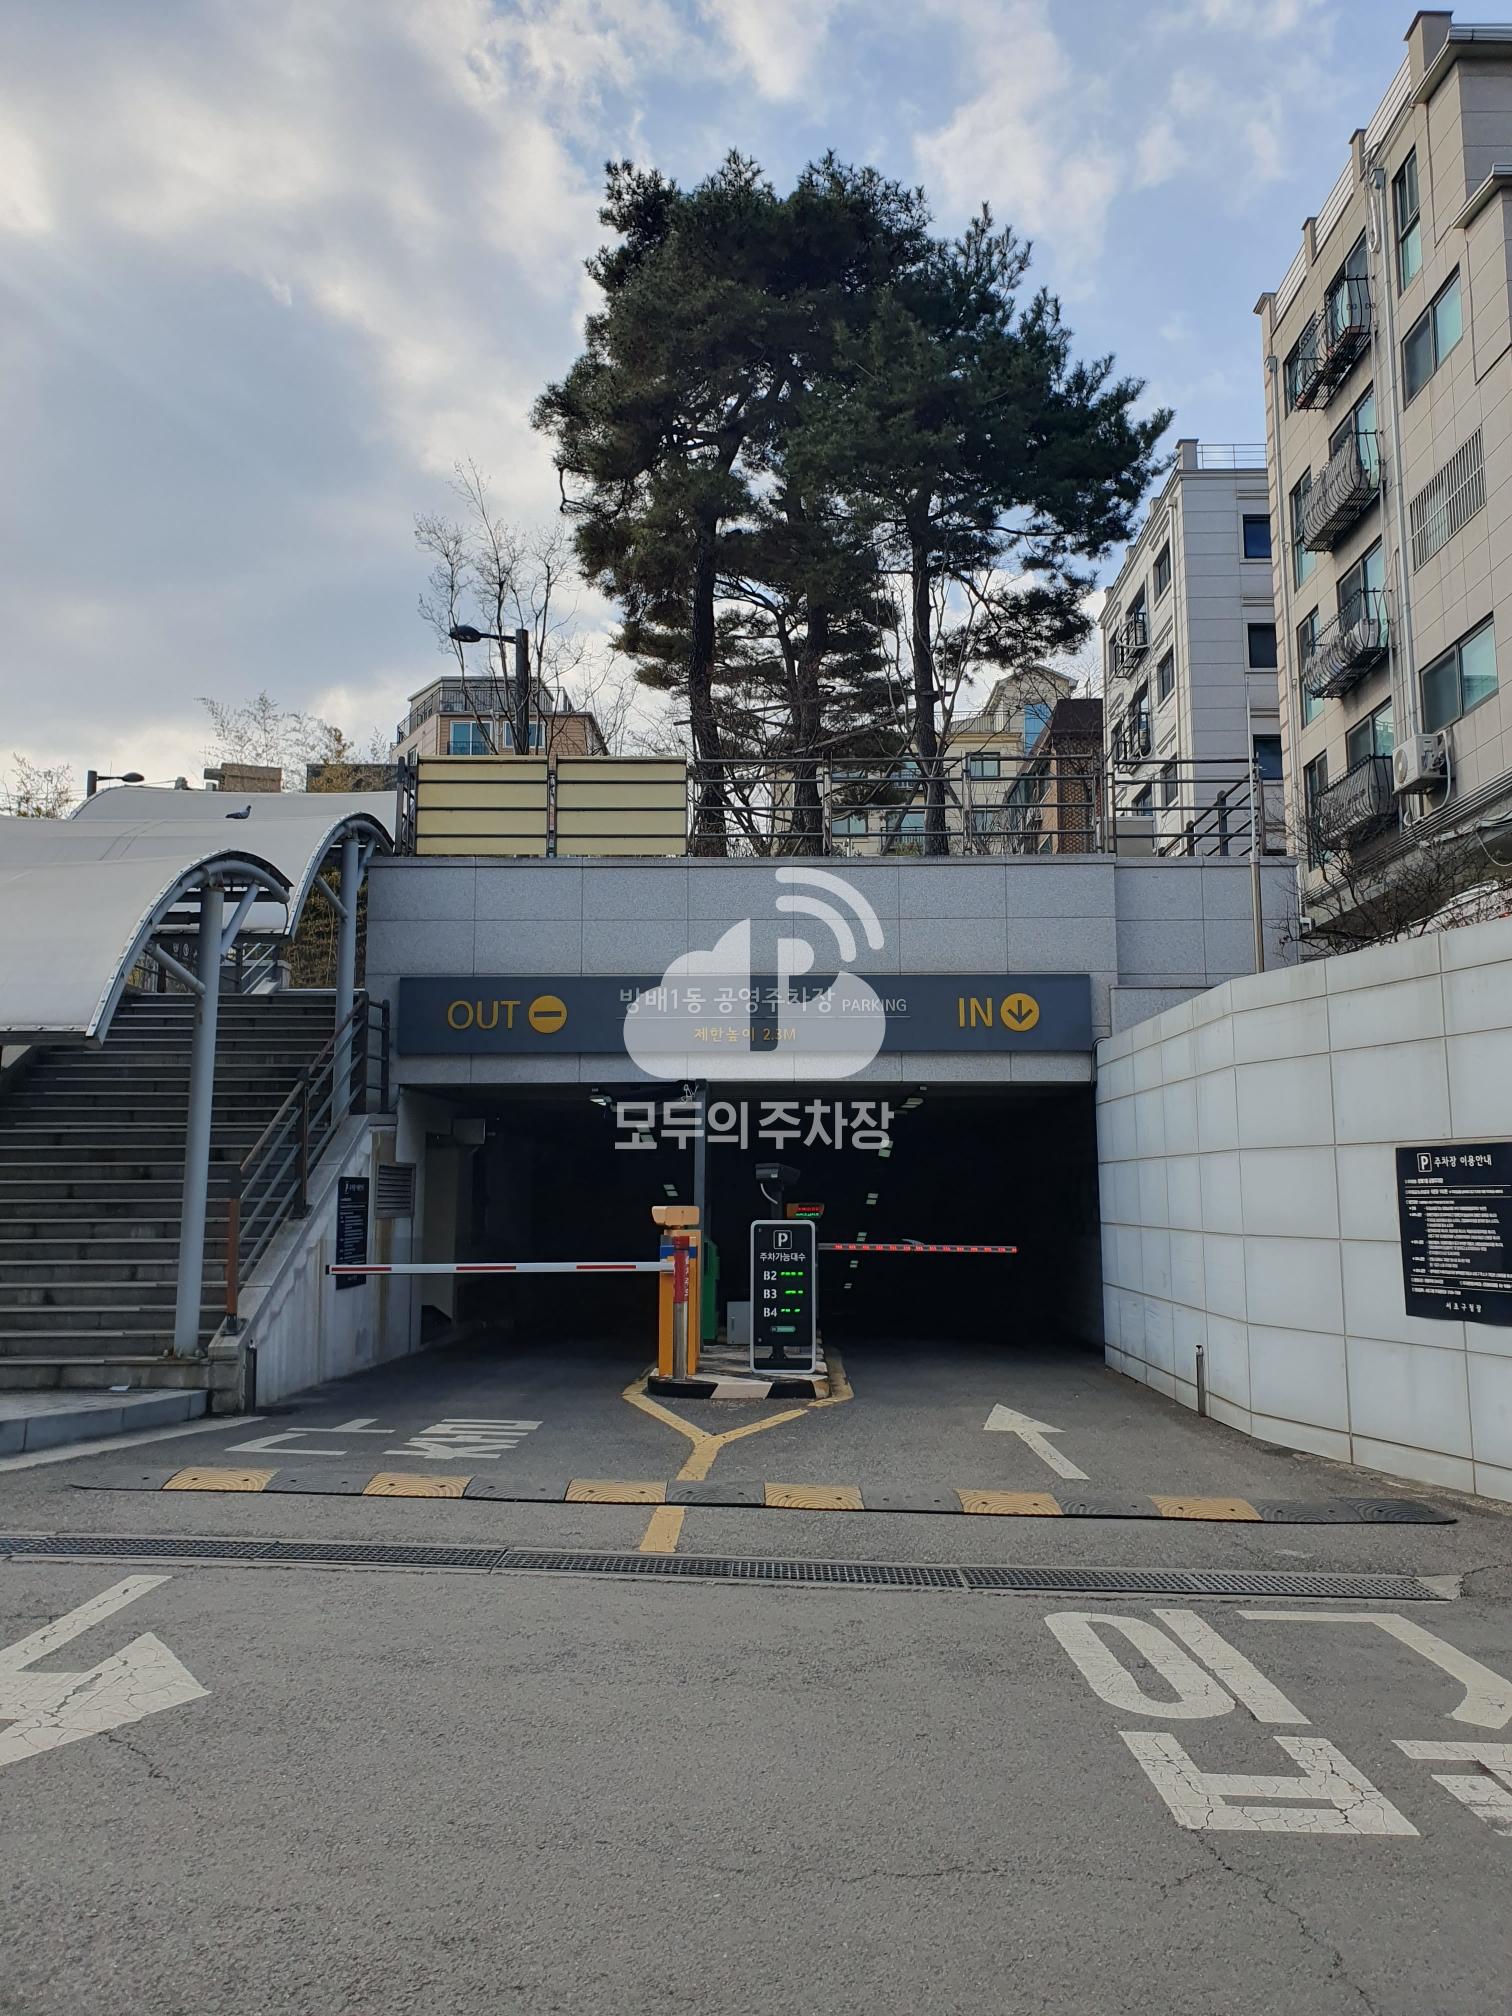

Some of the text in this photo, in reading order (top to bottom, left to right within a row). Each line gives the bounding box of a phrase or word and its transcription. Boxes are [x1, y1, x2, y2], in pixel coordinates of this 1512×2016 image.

[619, 986, 907, 1014] 방배1동 공영주차장 PARKING
[447, 999, 521, 1030] OUT
[958, 996, 994, 1028] IN
[693, 1025, 797, 1042] 제한높이 2.3M
[1434, 1155, 1457, 1168] 주차장
[777, 1232, 789, 1247] P
[759, 1252, 807, 1262] 주차가능대수
[763, 1270, 777, 1281] B2
[763, 1288, 777, 1299] B3
[763, 1307, 778, 1317] B4
